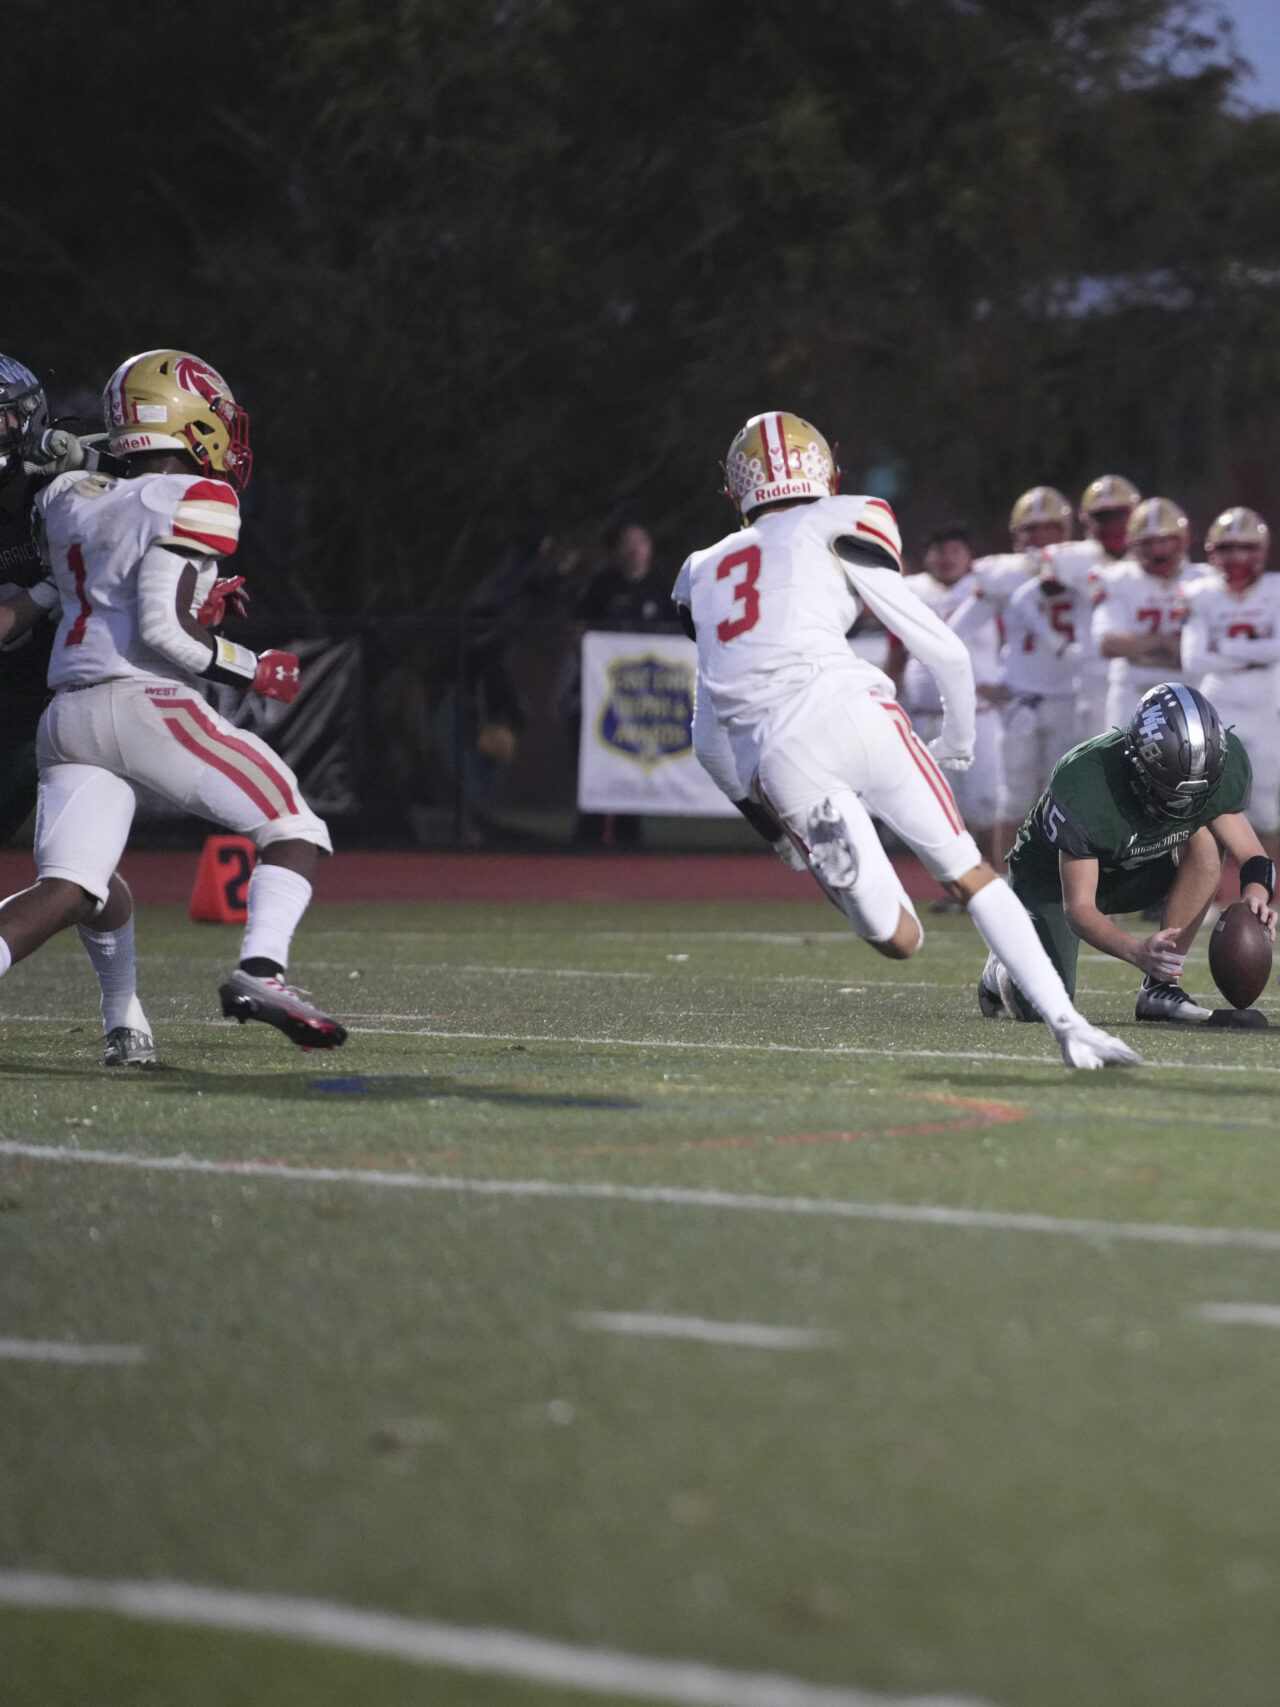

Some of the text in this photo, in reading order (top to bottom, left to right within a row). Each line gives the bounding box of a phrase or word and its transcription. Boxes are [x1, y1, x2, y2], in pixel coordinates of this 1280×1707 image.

[789, 448, 803, 471] 3
[755, 481, 812, 502] Riddell
[65, 543, 93, 648] 1
[716, 545, 762, 643] 3
[144, 687, 178, 697] WEST
[1139, 703, 1167, 763] WHB
[1043, 804, 1066, 843] 5
